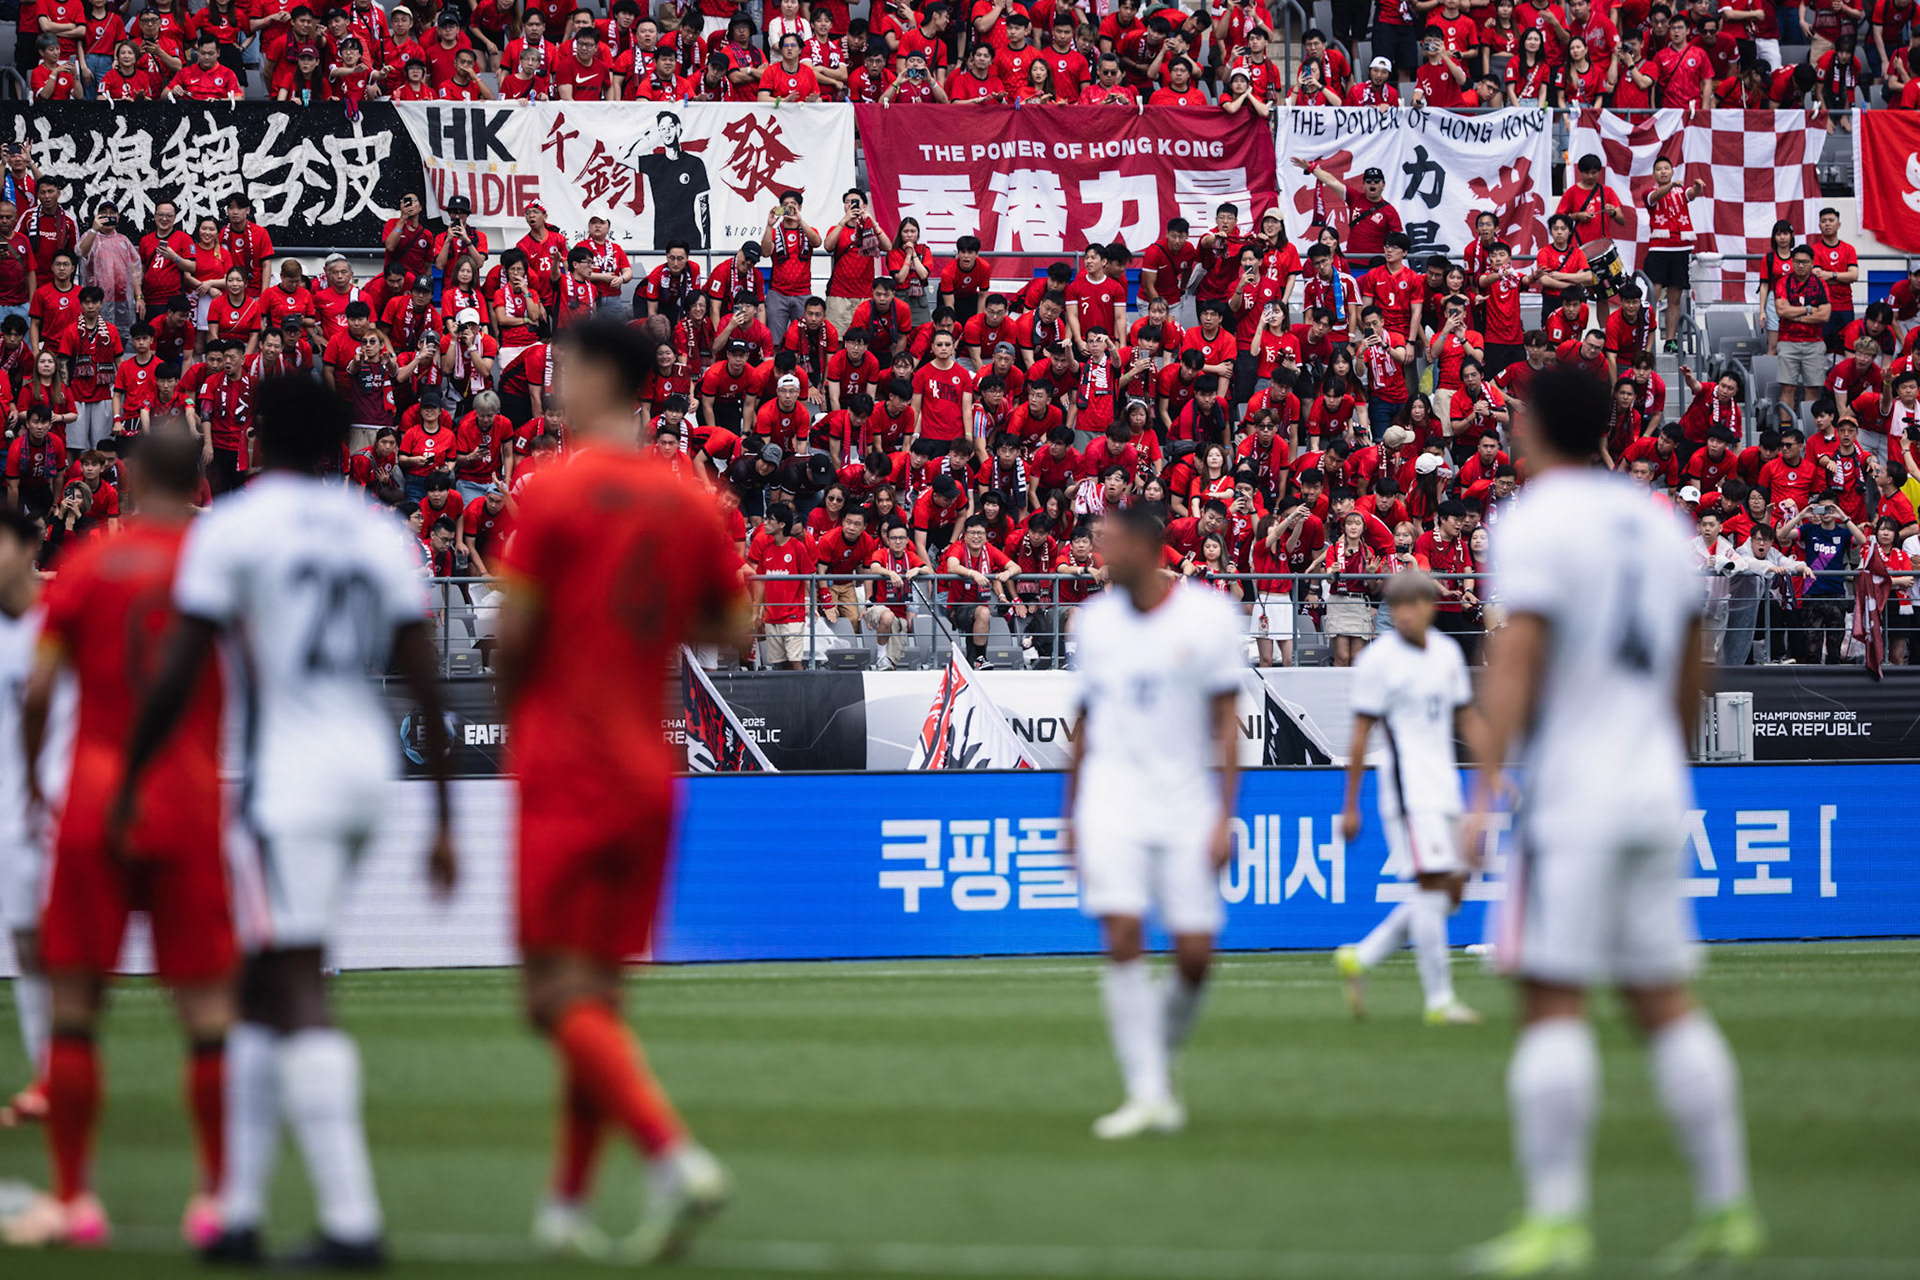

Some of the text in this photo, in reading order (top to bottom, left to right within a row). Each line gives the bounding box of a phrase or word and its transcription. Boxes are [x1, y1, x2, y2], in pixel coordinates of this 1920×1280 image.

[427, 107, 517, 162] HK
[1291, 106, 1546, 143] THE POWER OF HONG KONG
[919, 137, 1224, 162] THE POWER OF HONG KONG
[482, 172, 541, 217] DIE
[897, 167, 1254, 252] 香港力量
[1753, 711, 1857, 721] CHAMPIONSHIP 2025
[1792, 722, 1872, 736] REPUBLIC
[464, 724, 511, 745] EAFF
